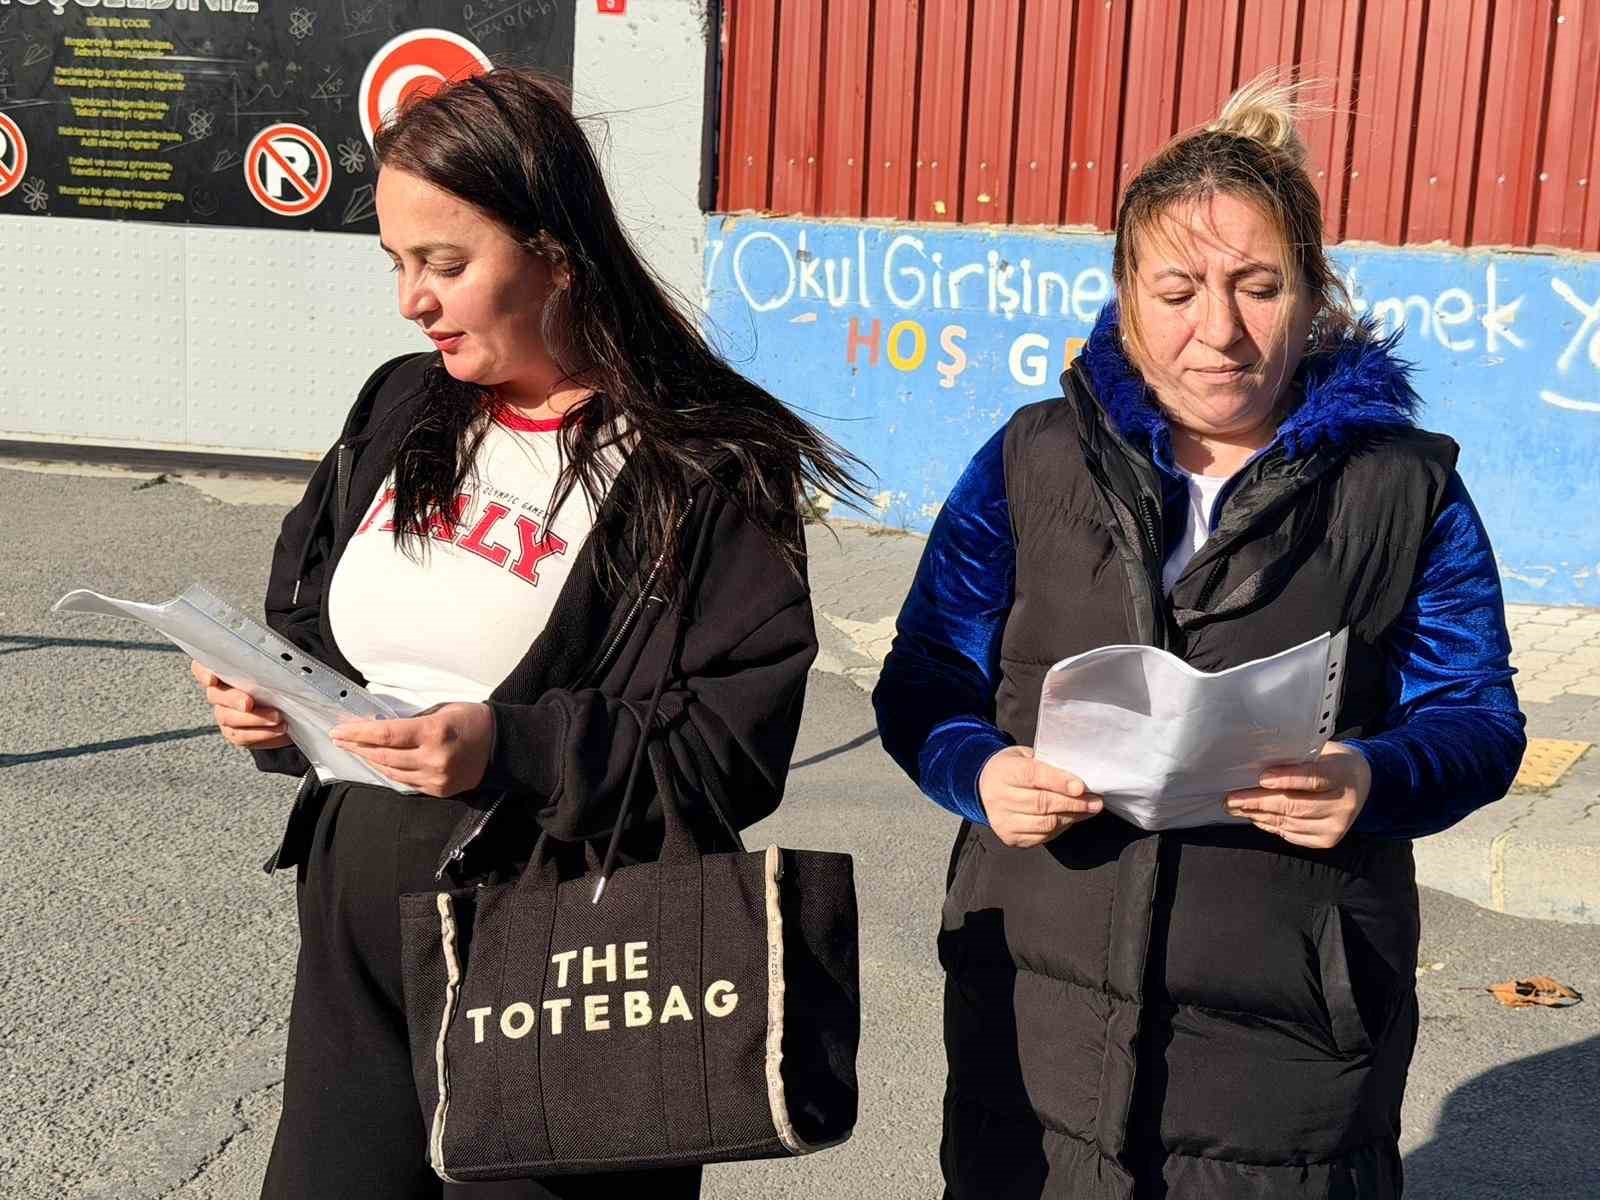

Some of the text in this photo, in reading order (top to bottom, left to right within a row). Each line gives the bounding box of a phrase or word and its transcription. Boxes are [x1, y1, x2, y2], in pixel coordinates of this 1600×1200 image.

[733, 229, 872, 312] Okul
[847, 316, 968, 389] HOŞ
[520, 501, 546, 520] GAME
[551, 941, 649, 988] THE
